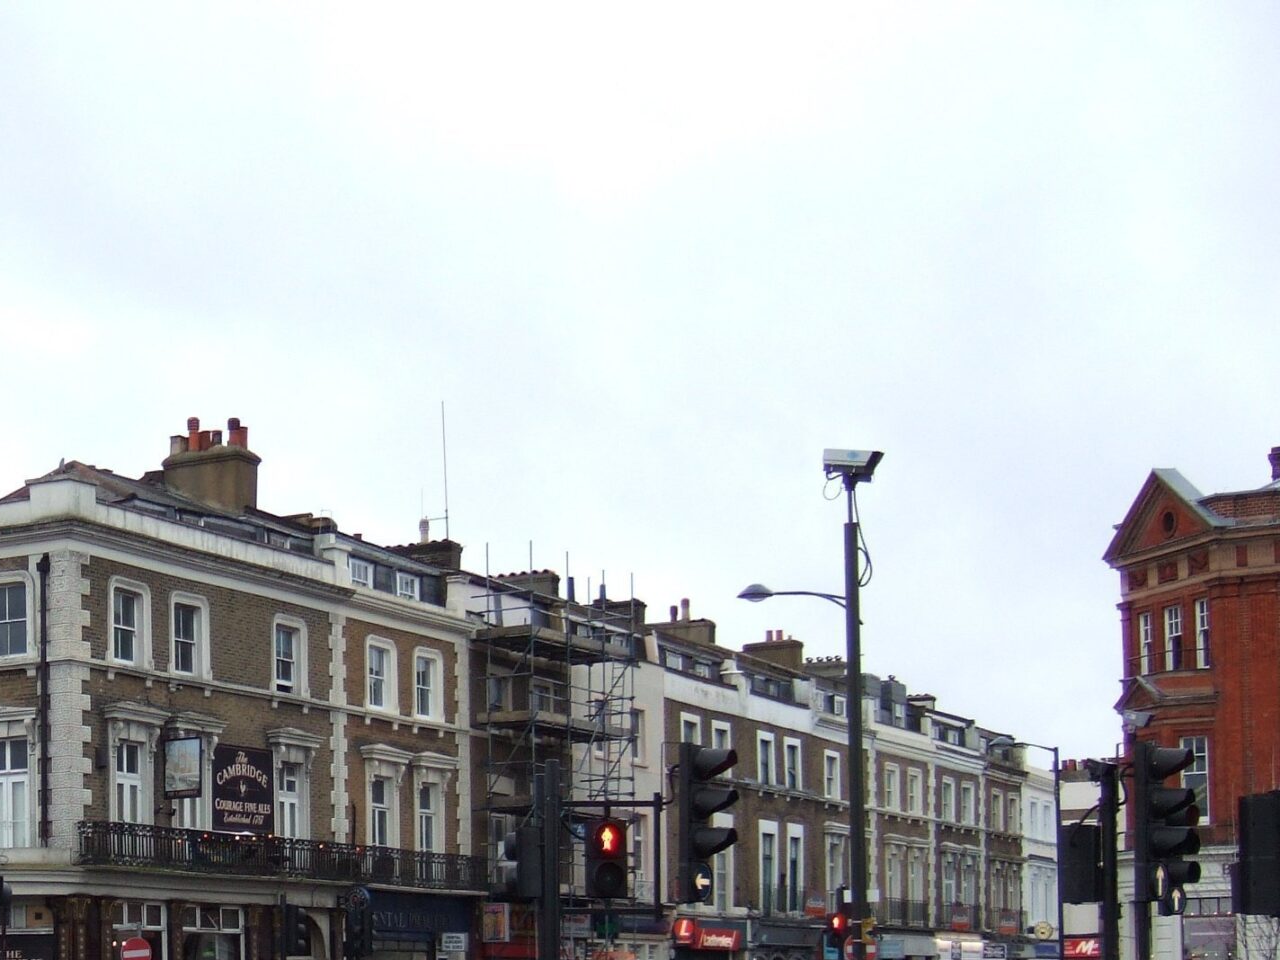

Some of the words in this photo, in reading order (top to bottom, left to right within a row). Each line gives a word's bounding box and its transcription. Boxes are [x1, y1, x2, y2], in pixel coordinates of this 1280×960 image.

[235, 751, 249, 764] The
[216, 764, 268, 788] CAMBRIDGE
[214, 798, 244, 812] COURAGE
[244, 801, 258, 813] FINE
[258, 803, 271, 814] ALES
[223, 811, 252, 824] Established
[373, 911, 406, 928] ENTAL
[679, 920, 690, 936] L
